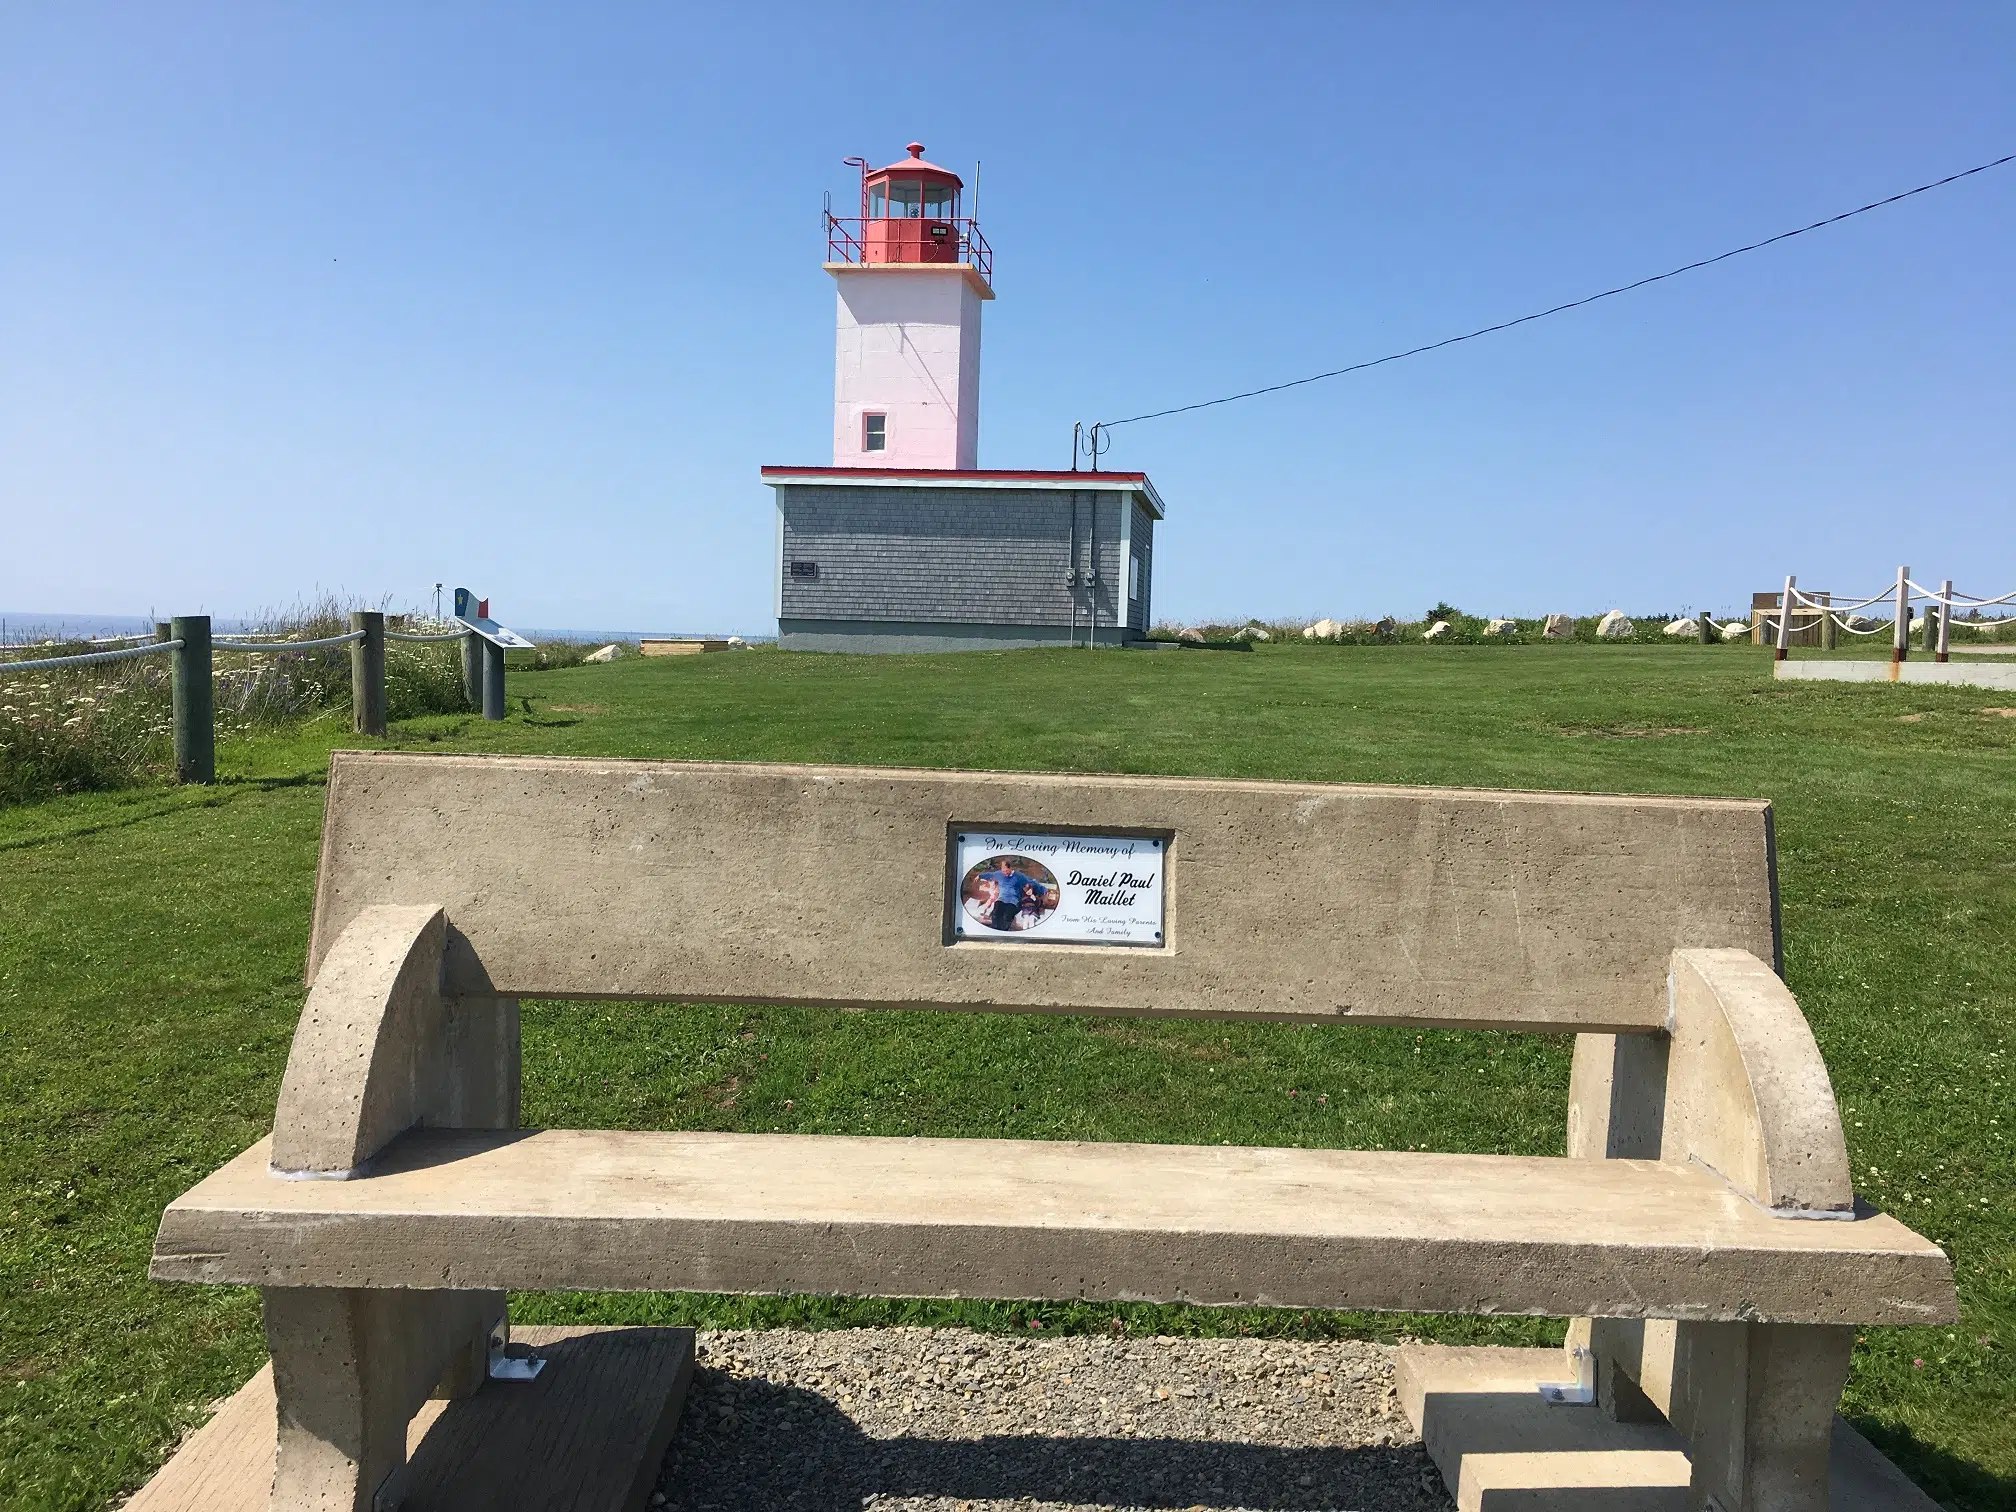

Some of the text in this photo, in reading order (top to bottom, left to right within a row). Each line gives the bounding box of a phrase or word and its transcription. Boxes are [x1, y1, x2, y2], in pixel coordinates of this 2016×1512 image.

[985, 837, 1136, 859] In Loving Memory of
[1066, 870, 1156, 889] Daniel Paul
[1084, 888, 1136, 906] Maillet
[1061, 914, 1080, 923] From
[1098, 916, 1126, 926] Loving
[1128, 917, 1157, 926] Parents
[1086, 927, 1131, 937] And Family
